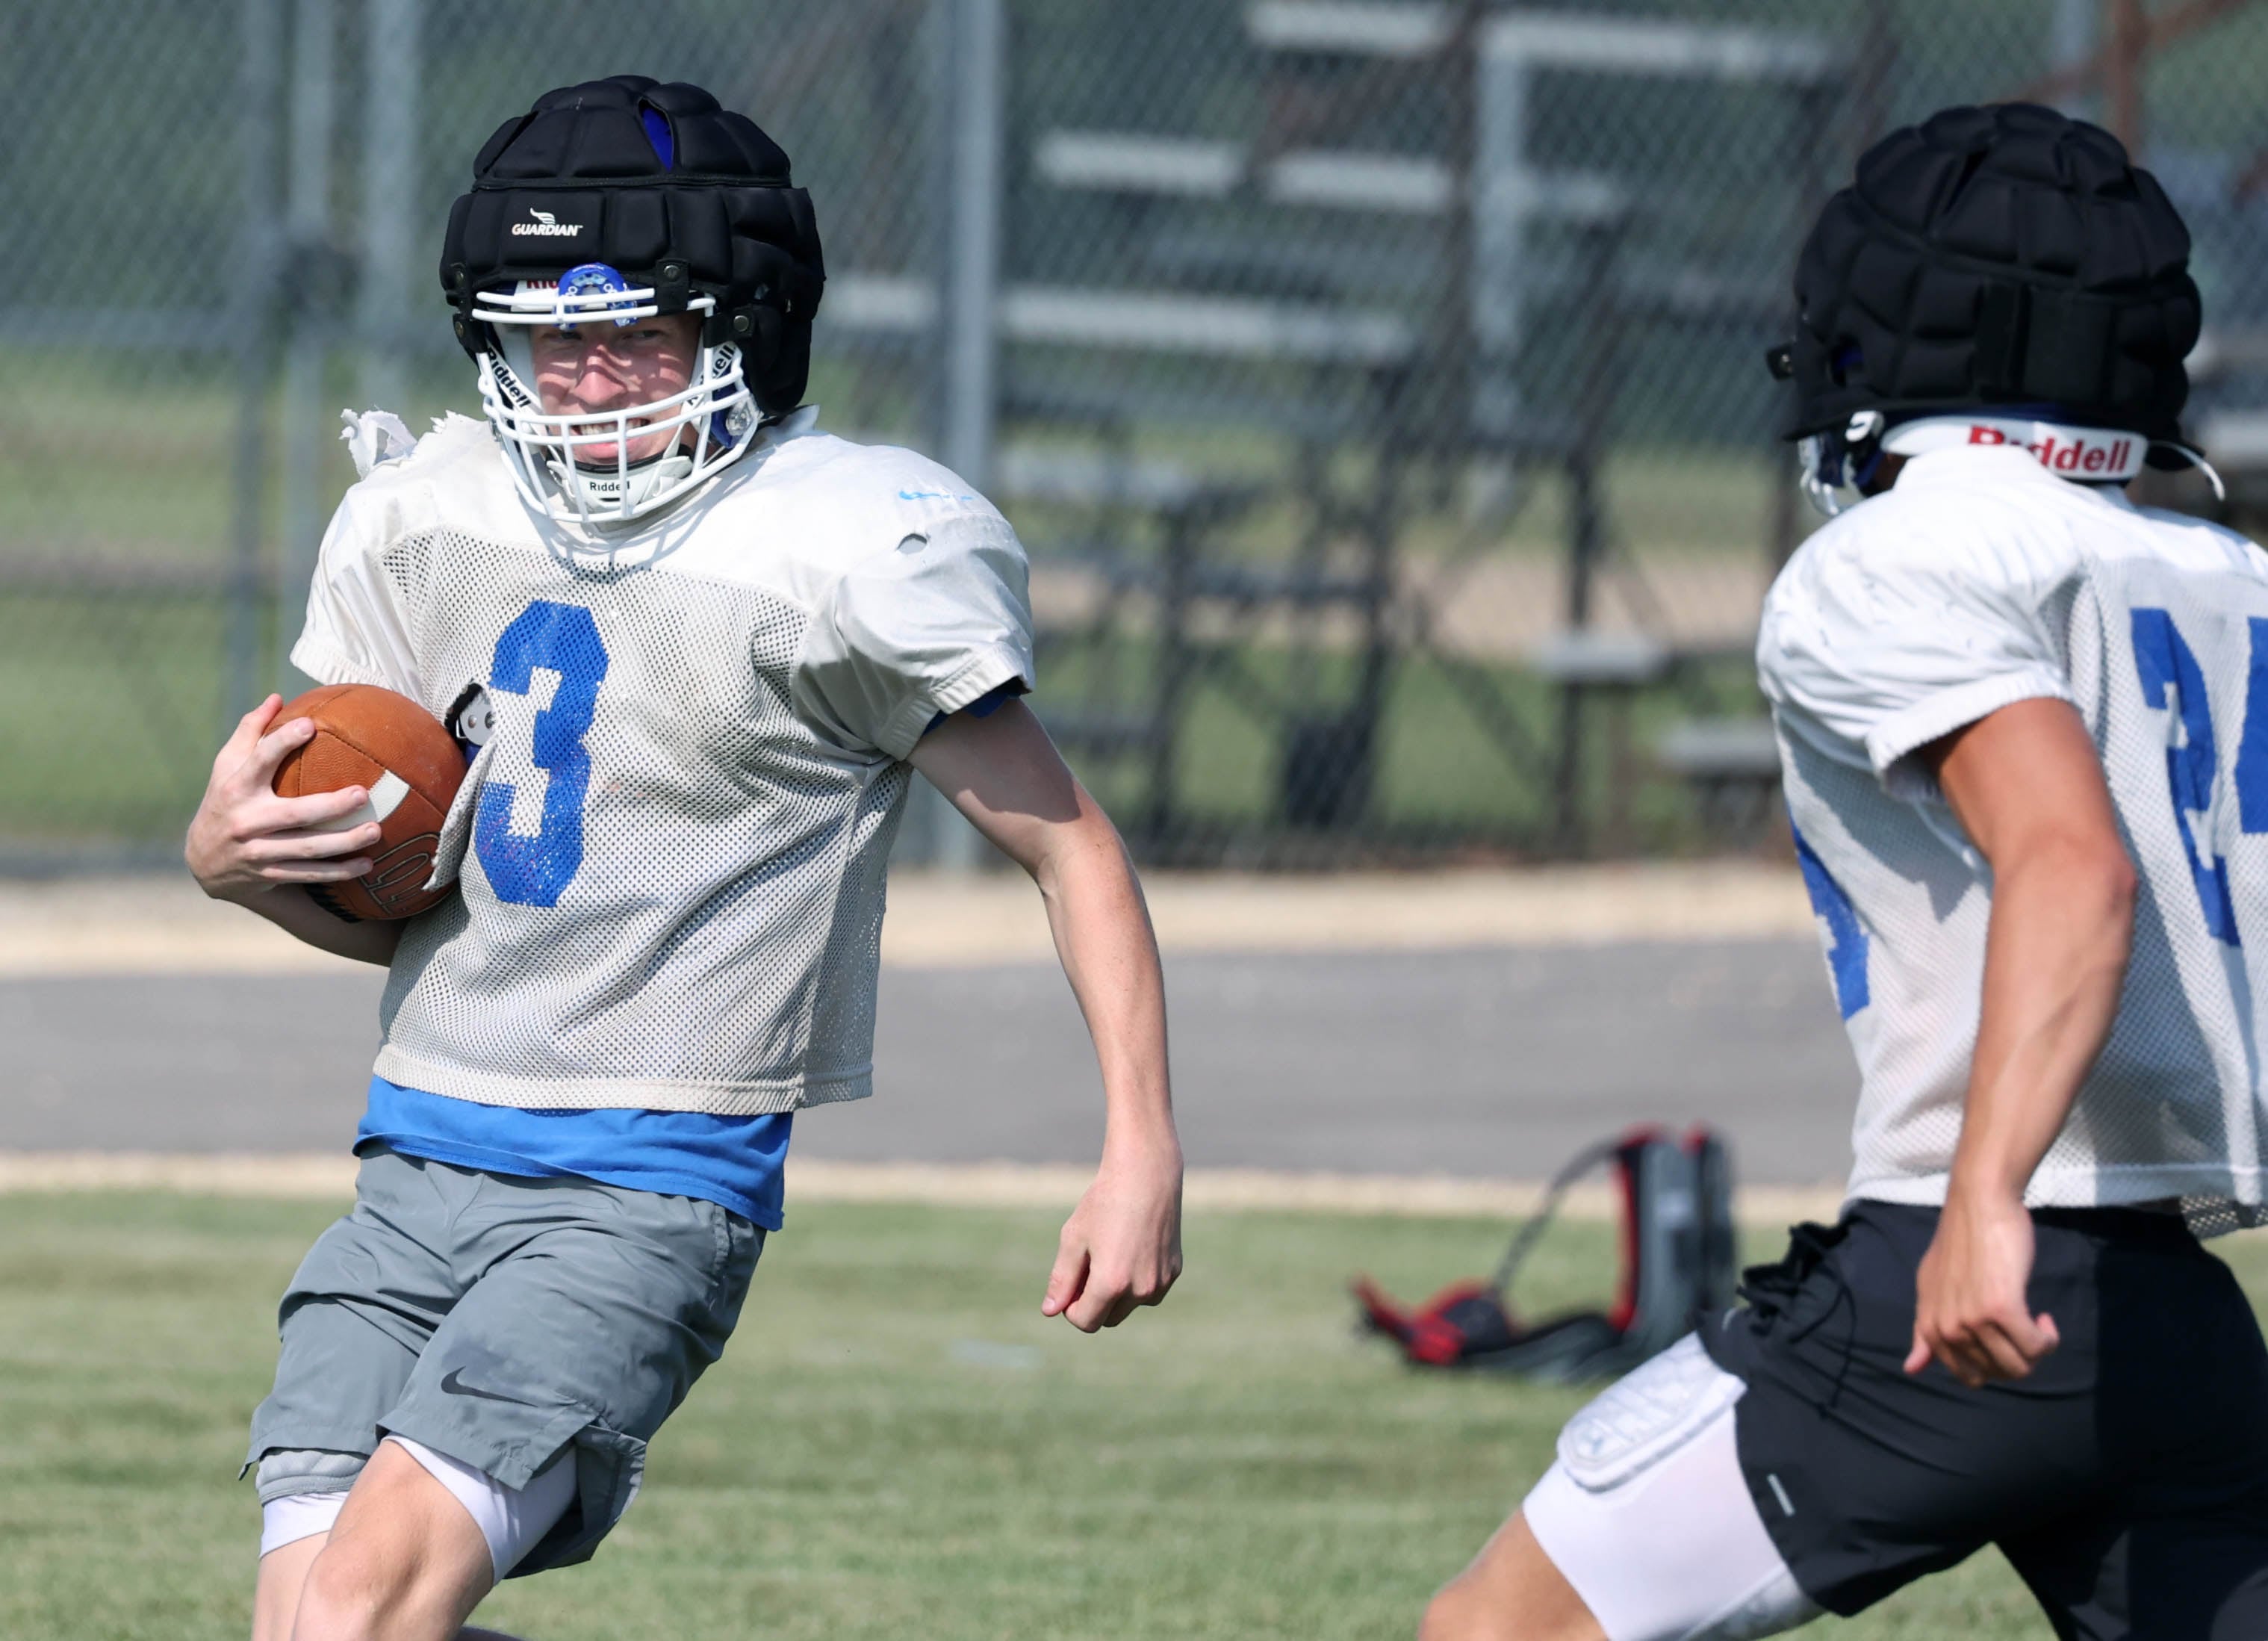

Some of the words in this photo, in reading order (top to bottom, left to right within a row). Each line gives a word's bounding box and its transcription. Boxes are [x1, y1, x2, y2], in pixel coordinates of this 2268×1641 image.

[512, 223, 578, 236] GUARDIAN
[1968, 424, 2131, 472] Rddell
[589, 481, 630, 491] Riddel
[474, 600, 610, 908] 3
